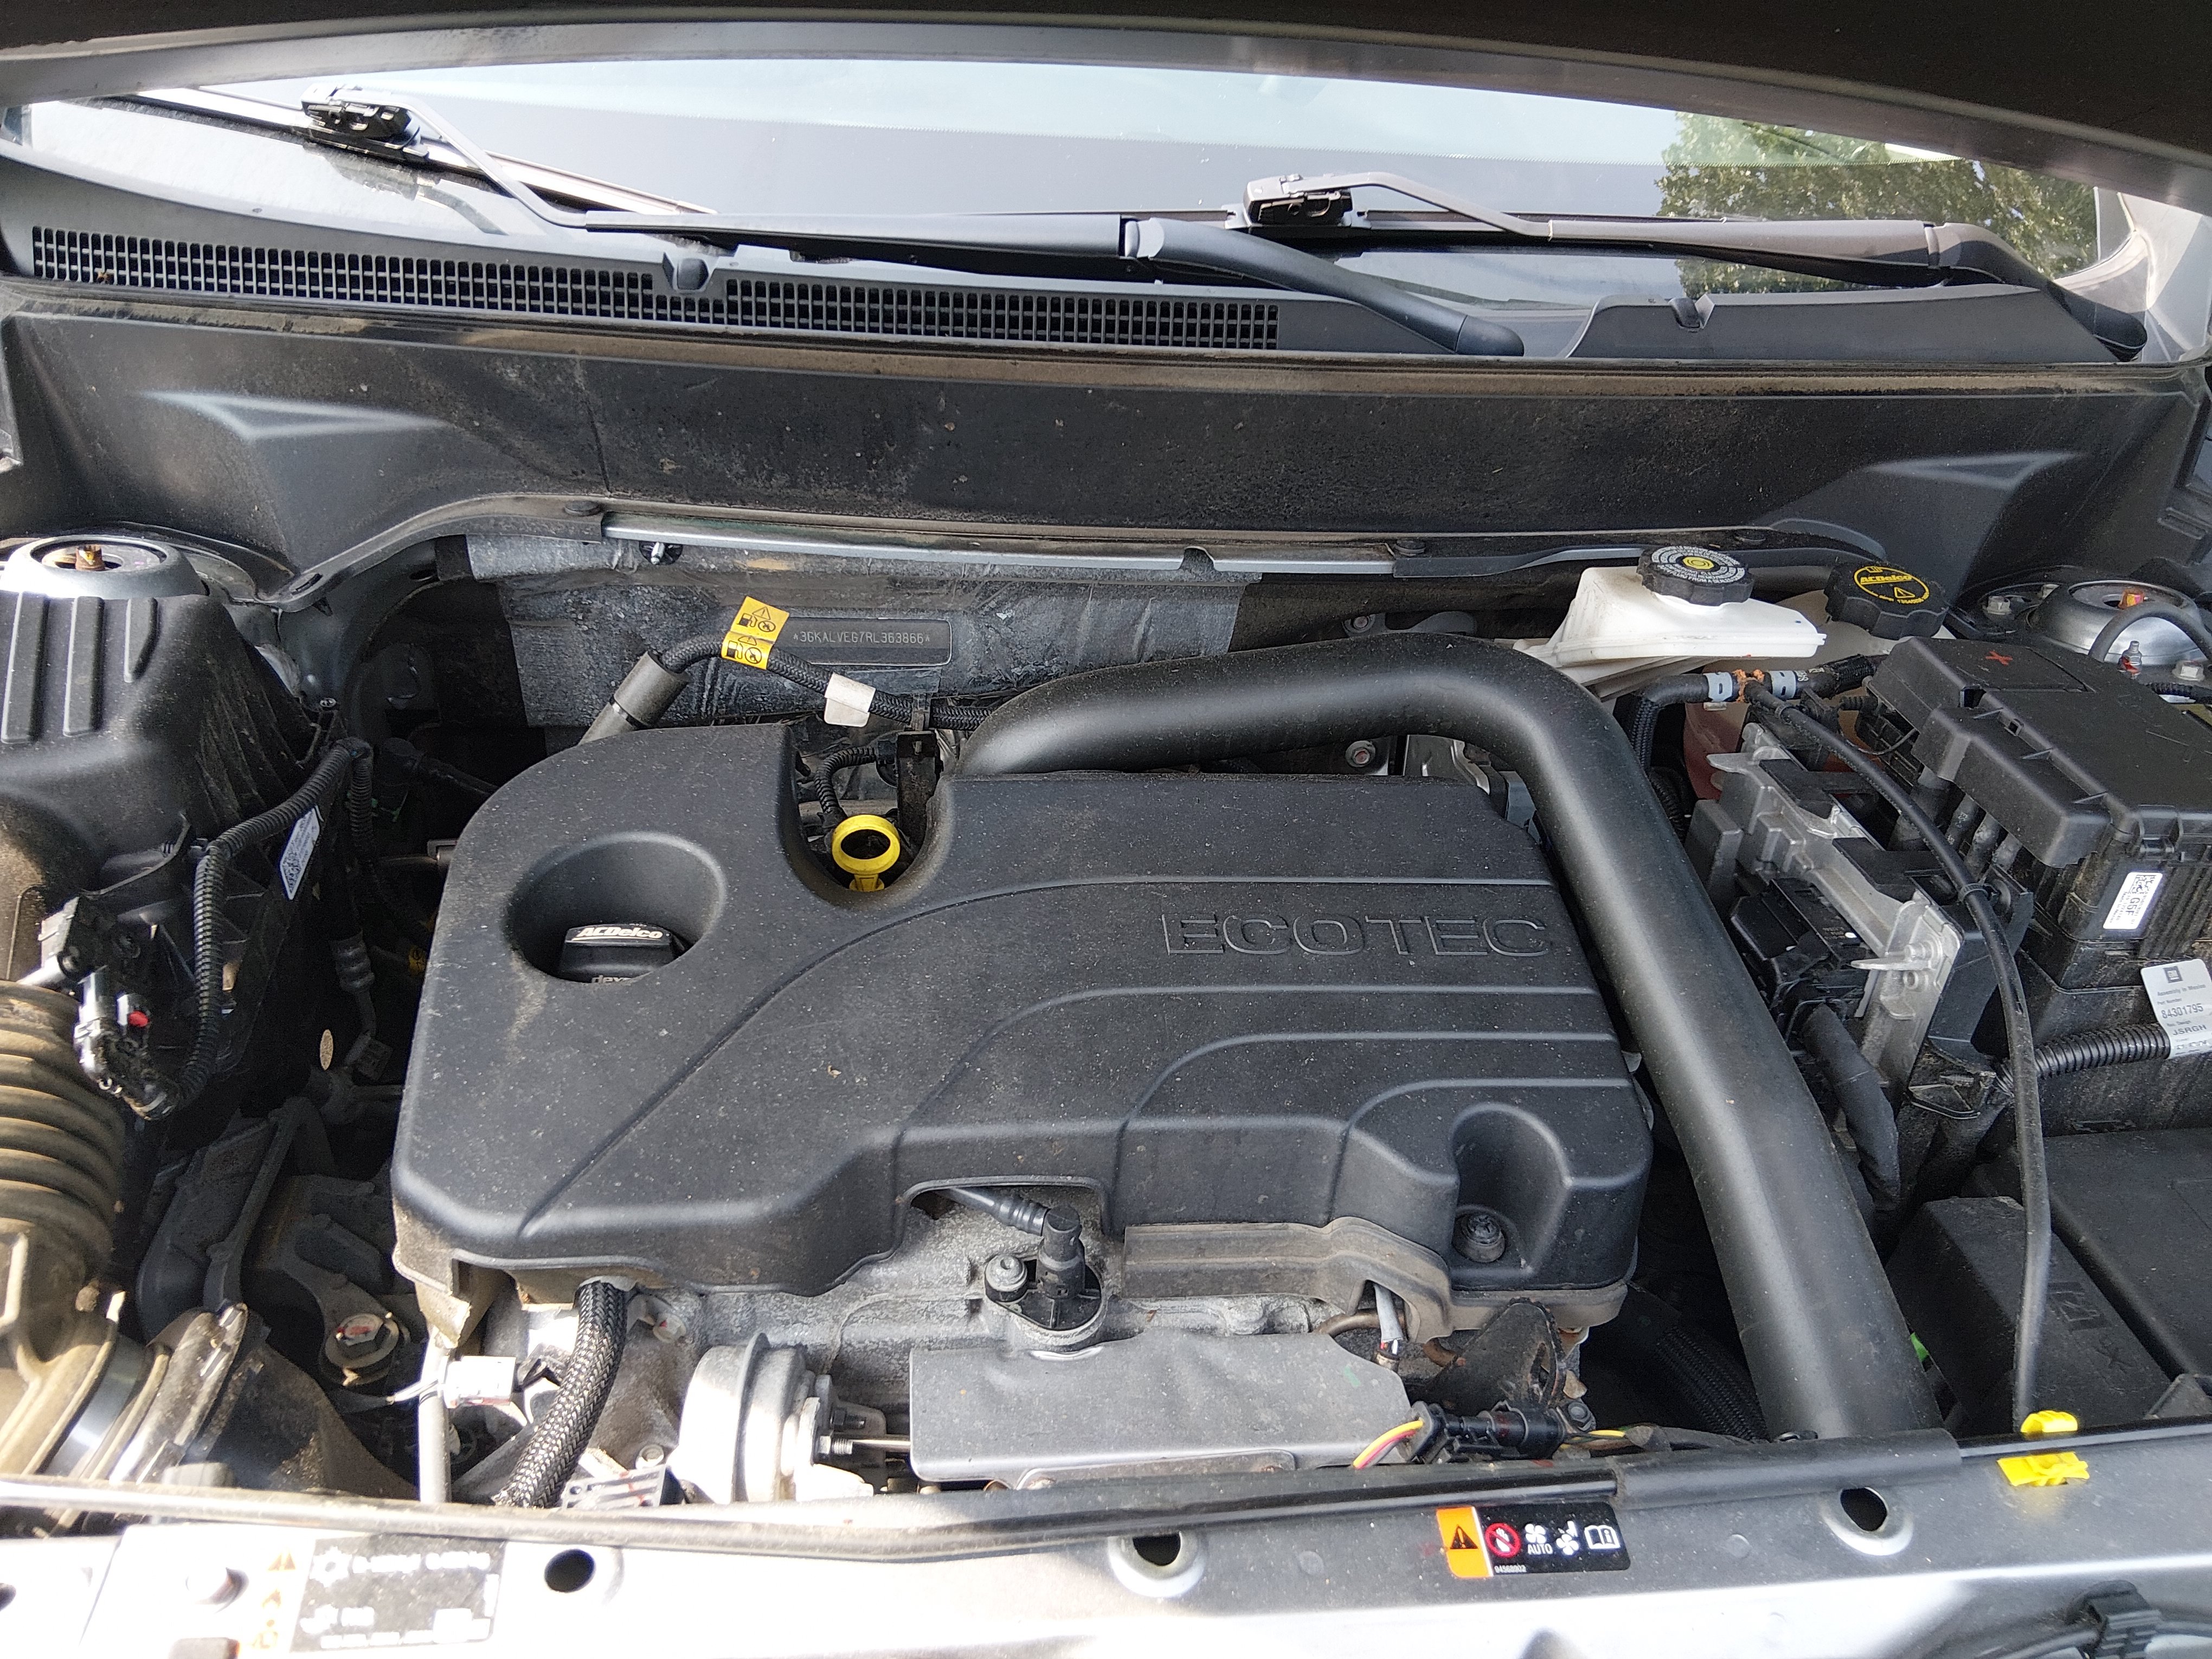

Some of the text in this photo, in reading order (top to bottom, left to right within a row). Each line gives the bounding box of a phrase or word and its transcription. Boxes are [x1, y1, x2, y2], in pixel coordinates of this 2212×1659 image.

[1860, 575, 1913, 583] ACDelco
[2126, 897, 2140, 916] G5F
[576, 927, 663, 939] ACDelco
[1160, 913, 1551, 957] ECOTEC
[2161, 1003, 2204, 1019] 84301795
[2172, 1024, 2207, 1036] JSRGH
[1527, 1544, 1553, 1555] AUTO
